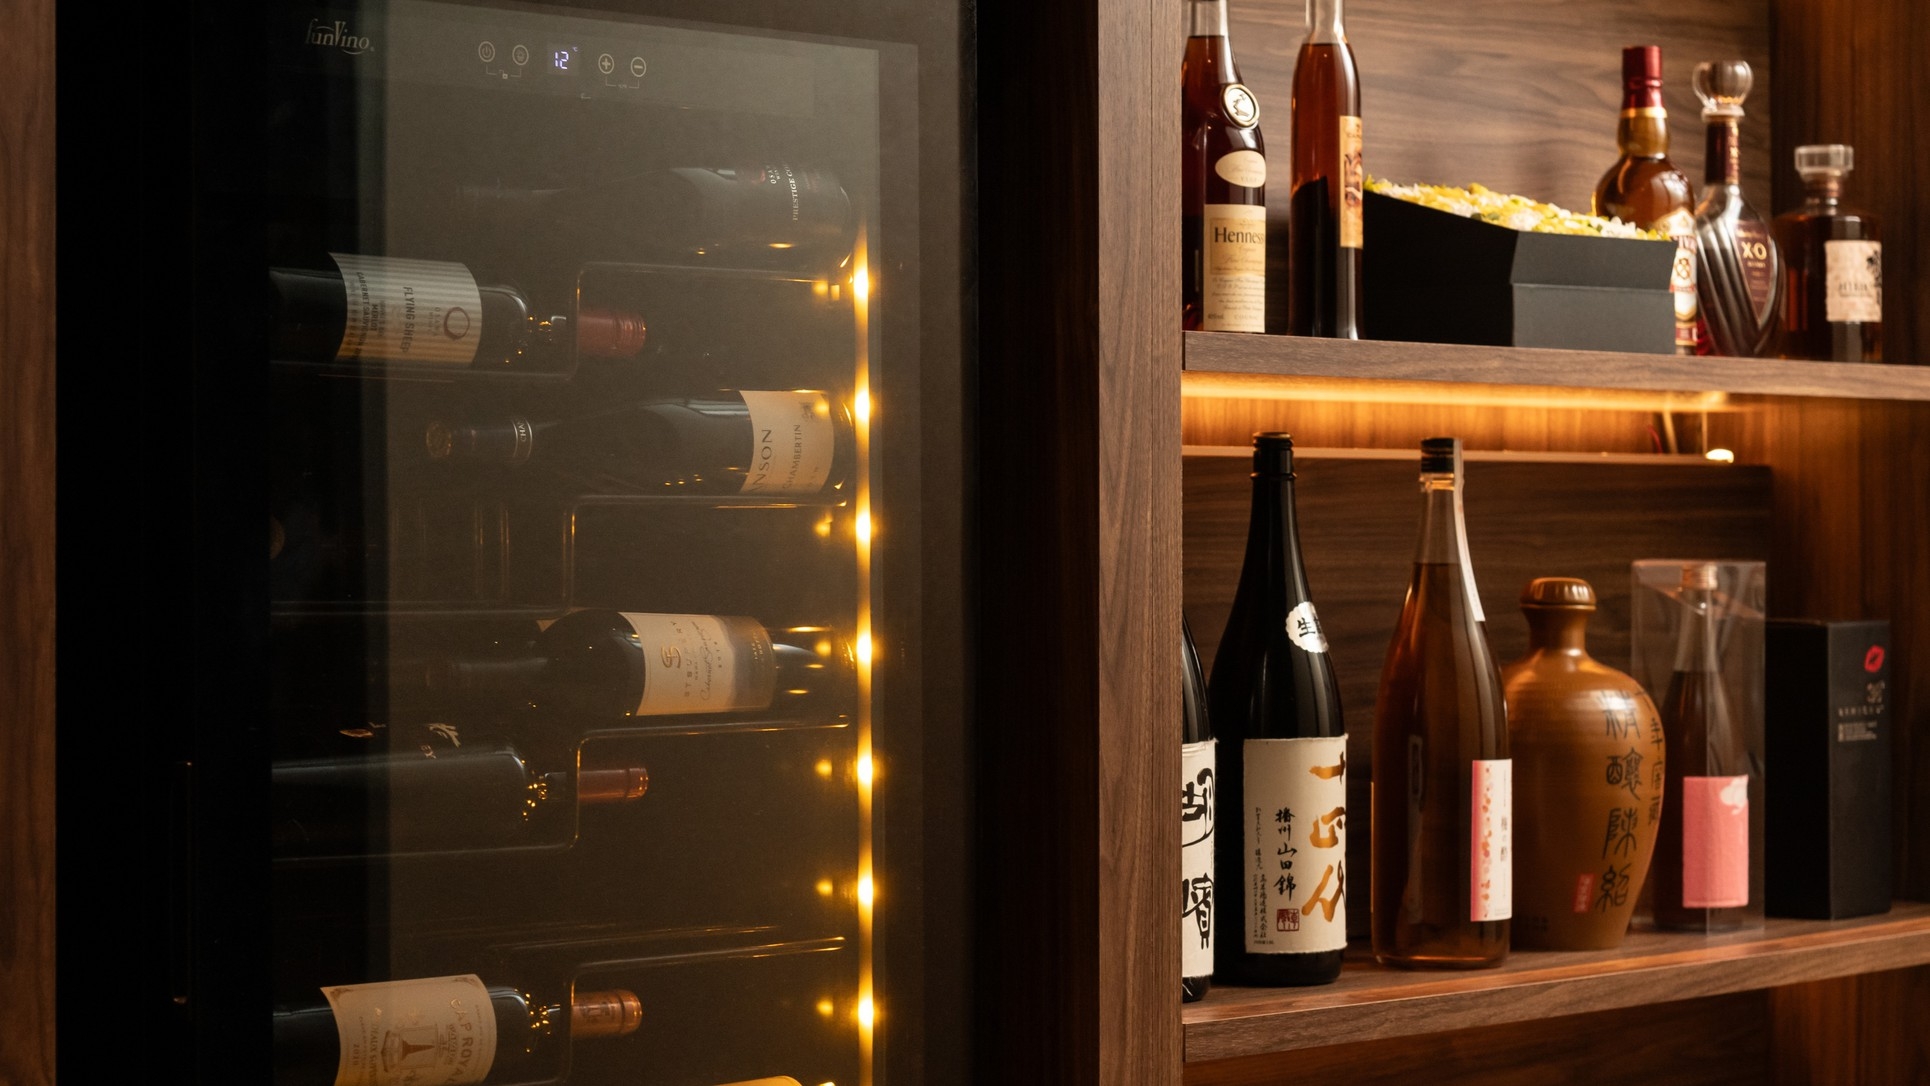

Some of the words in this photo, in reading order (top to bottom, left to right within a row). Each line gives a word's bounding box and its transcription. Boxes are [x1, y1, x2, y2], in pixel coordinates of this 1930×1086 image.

[305, 18, 371, 52] funVino
[553, 50, 570, 70] 12
[788, 178, 799, 221] PRESTIGE
[1741, 240, 1768, 261] XO
[356, 272, 370, 305] CABERNET
[403, 286, 415, 320] FLYING
[371, 304, 379, 332] MERLOT
[400, 321, 414, 353] SHEEP
[1302, 752, 1347, 922] 十四代
[1274, 807, 1298, 901] 播州山田錦
